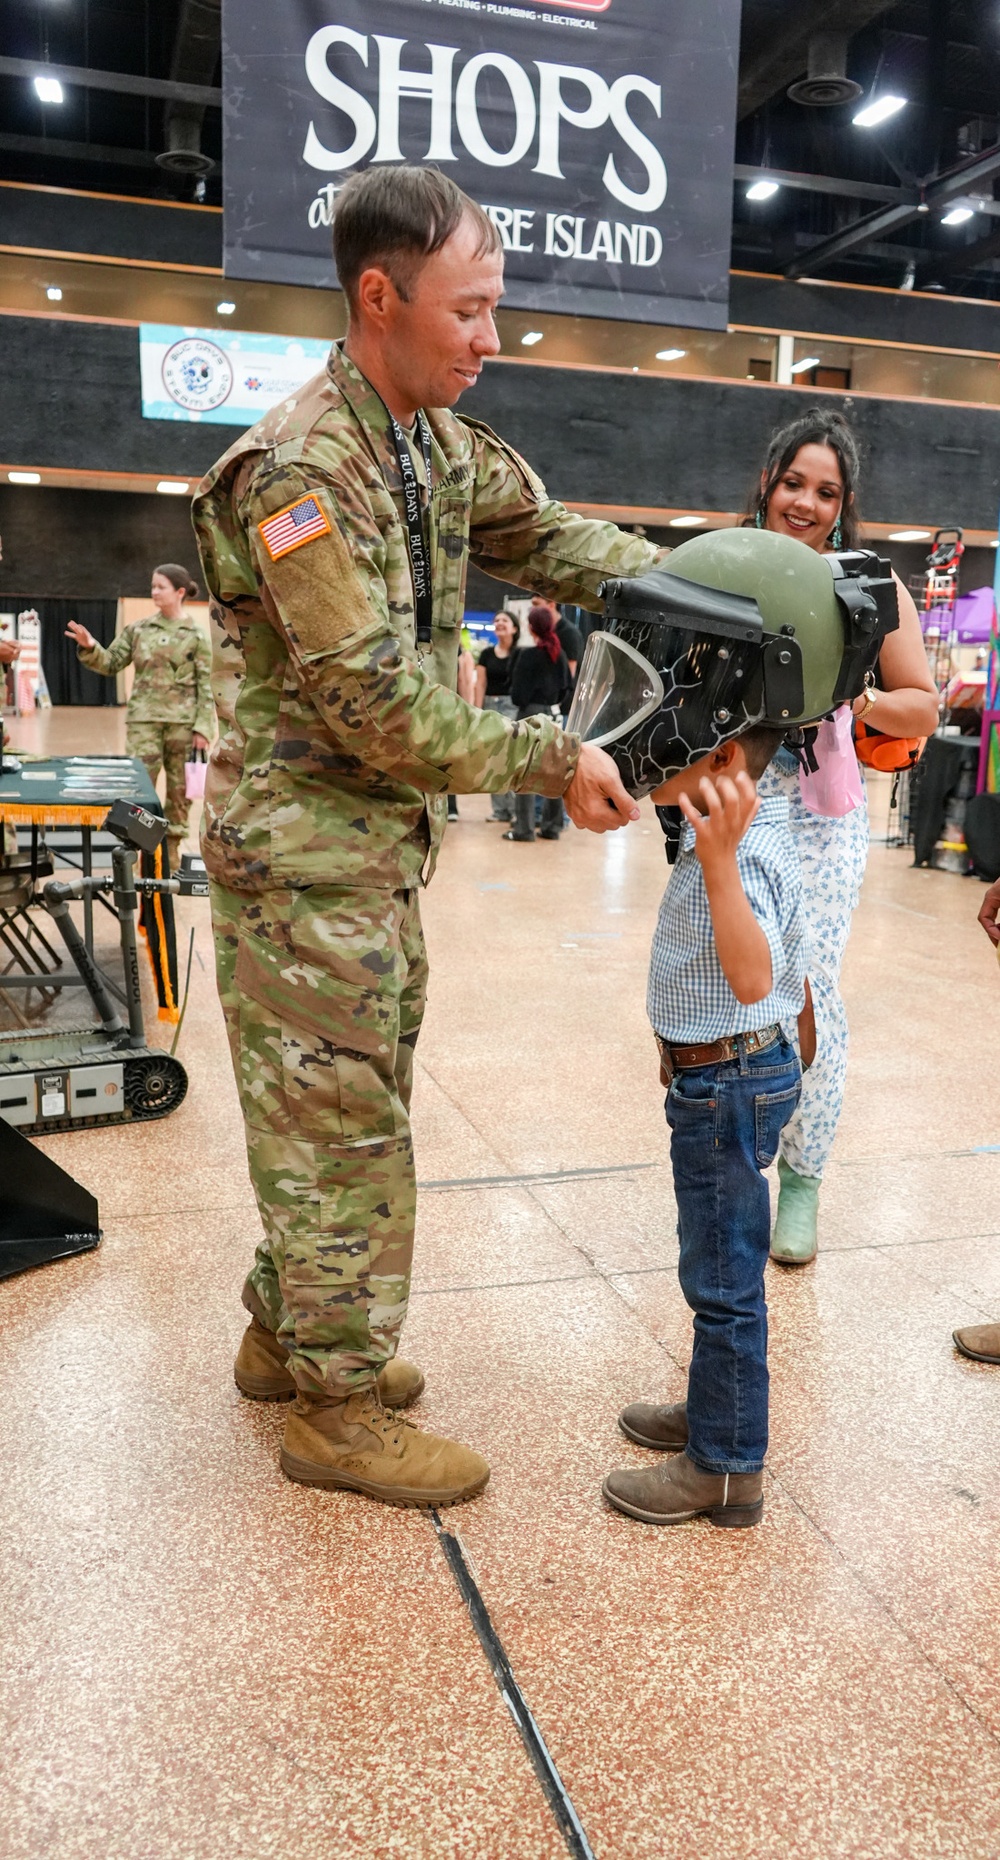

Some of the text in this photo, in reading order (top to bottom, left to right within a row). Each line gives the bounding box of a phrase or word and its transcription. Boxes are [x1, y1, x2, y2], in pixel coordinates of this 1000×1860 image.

[487, 4, 536, 20] PLUMBING
[542, 13, 598, 30] ELECTRICAL
[302, 24, 668, 212] SHOPS
[308, 183, 342, 229] at
[544, 213, 663, 267] ISLAND
[171, 343, 223, 365] BUC DAYS
[208, 374, 229, 404] EXPO
[400, 453, 419, 522] BUC DAYS
[440, 466, 470, 489] ARMY
[410, 534, 427, 598] BUC DAYS
